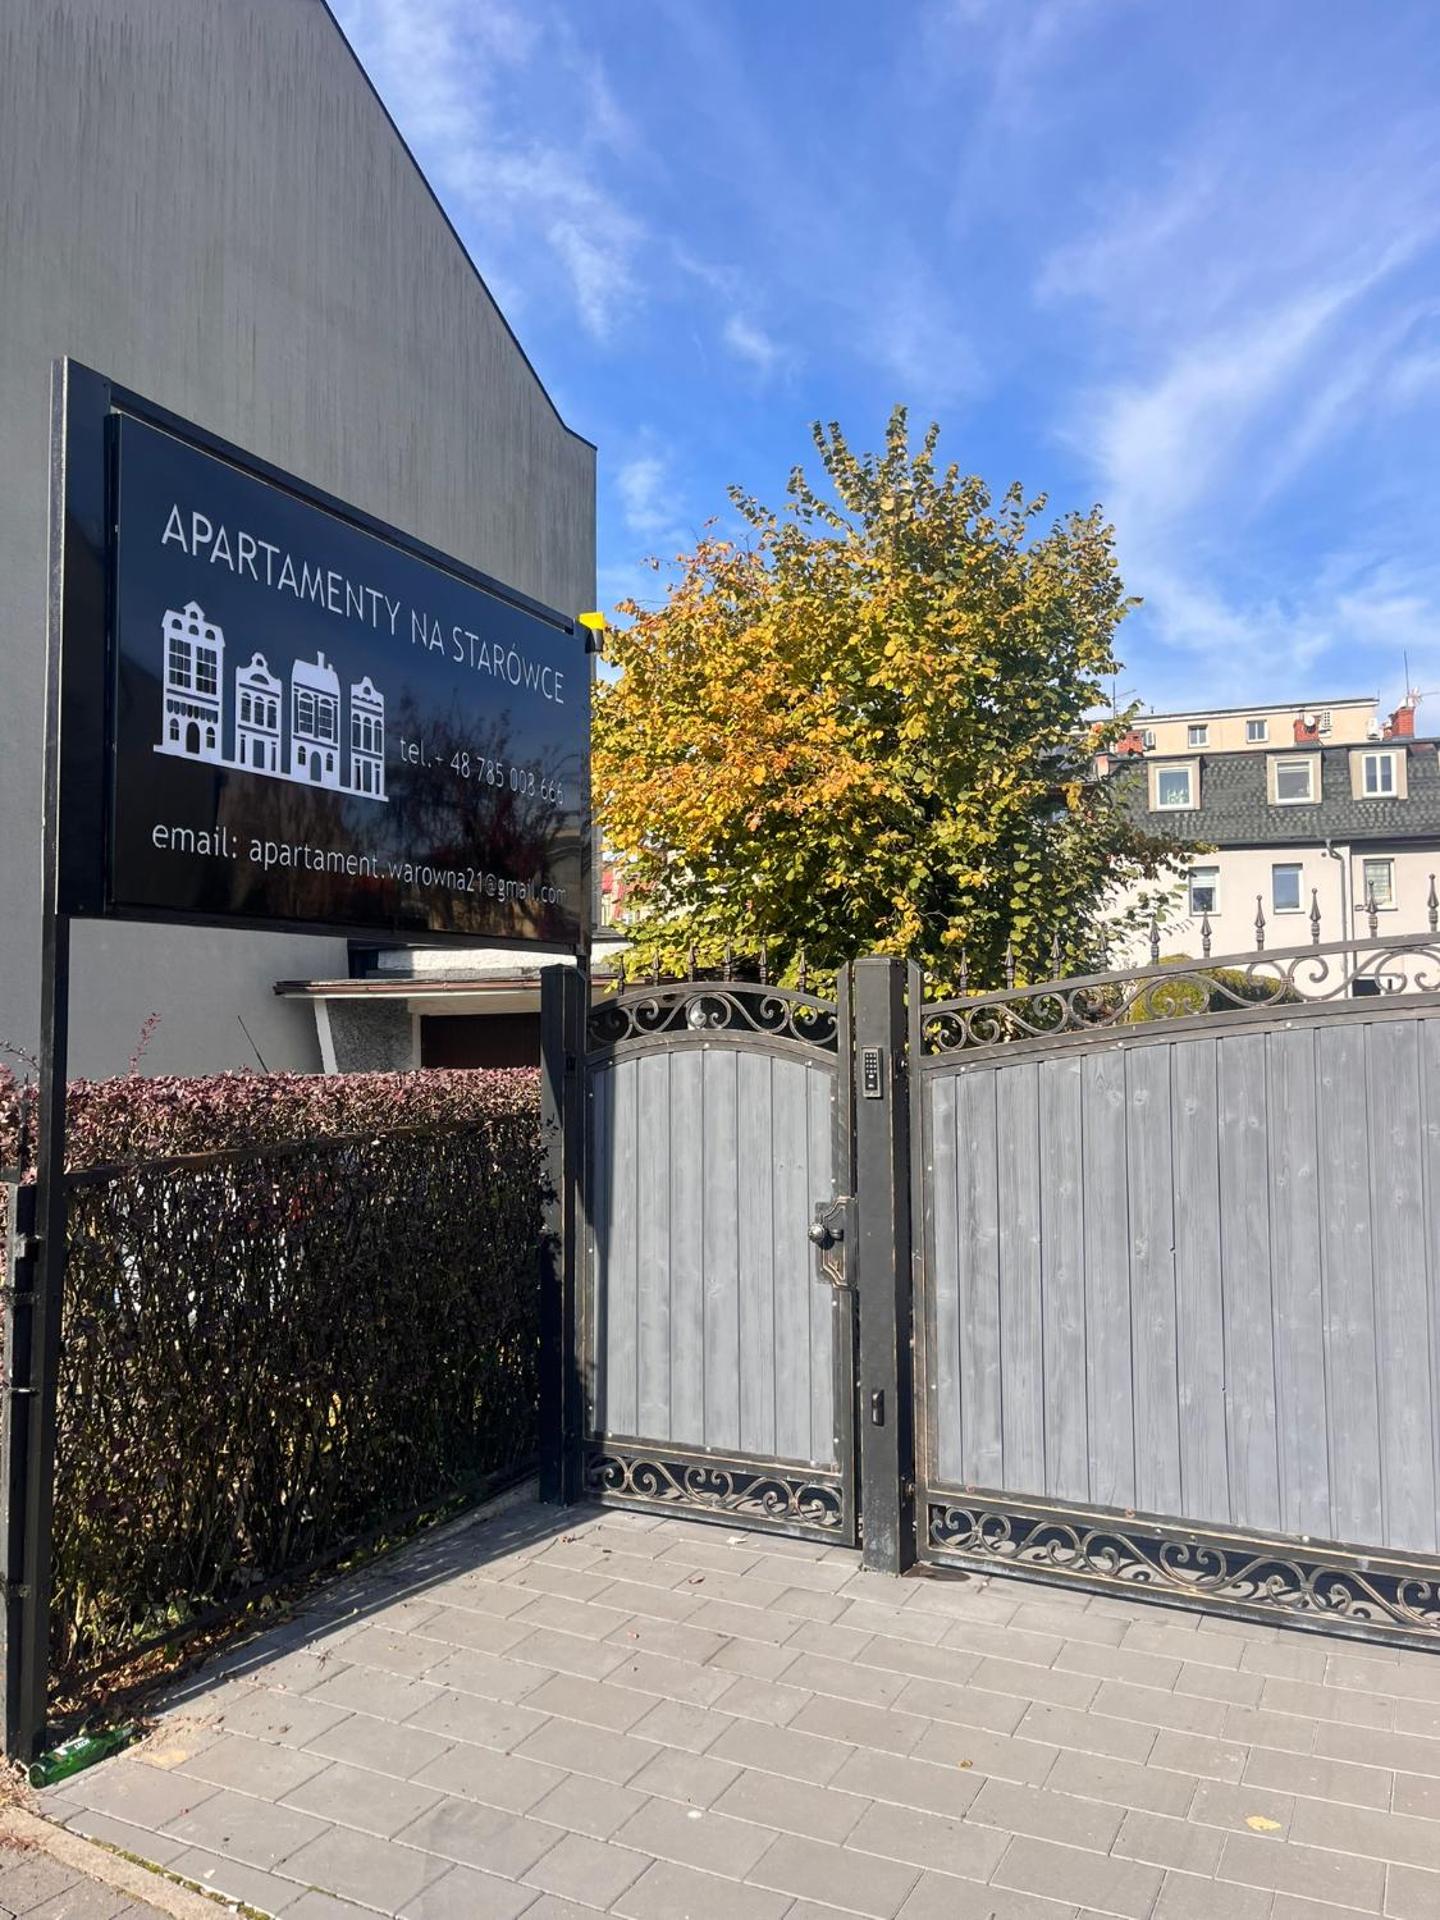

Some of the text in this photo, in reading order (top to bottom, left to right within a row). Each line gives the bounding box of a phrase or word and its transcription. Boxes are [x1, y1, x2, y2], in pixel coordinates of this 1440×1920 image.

[161, 503, 564, 704] APARTAMENTY NA STARÓWCE
[477, 756, 504, 787] 785
[152, 824, 237, 859] email:
